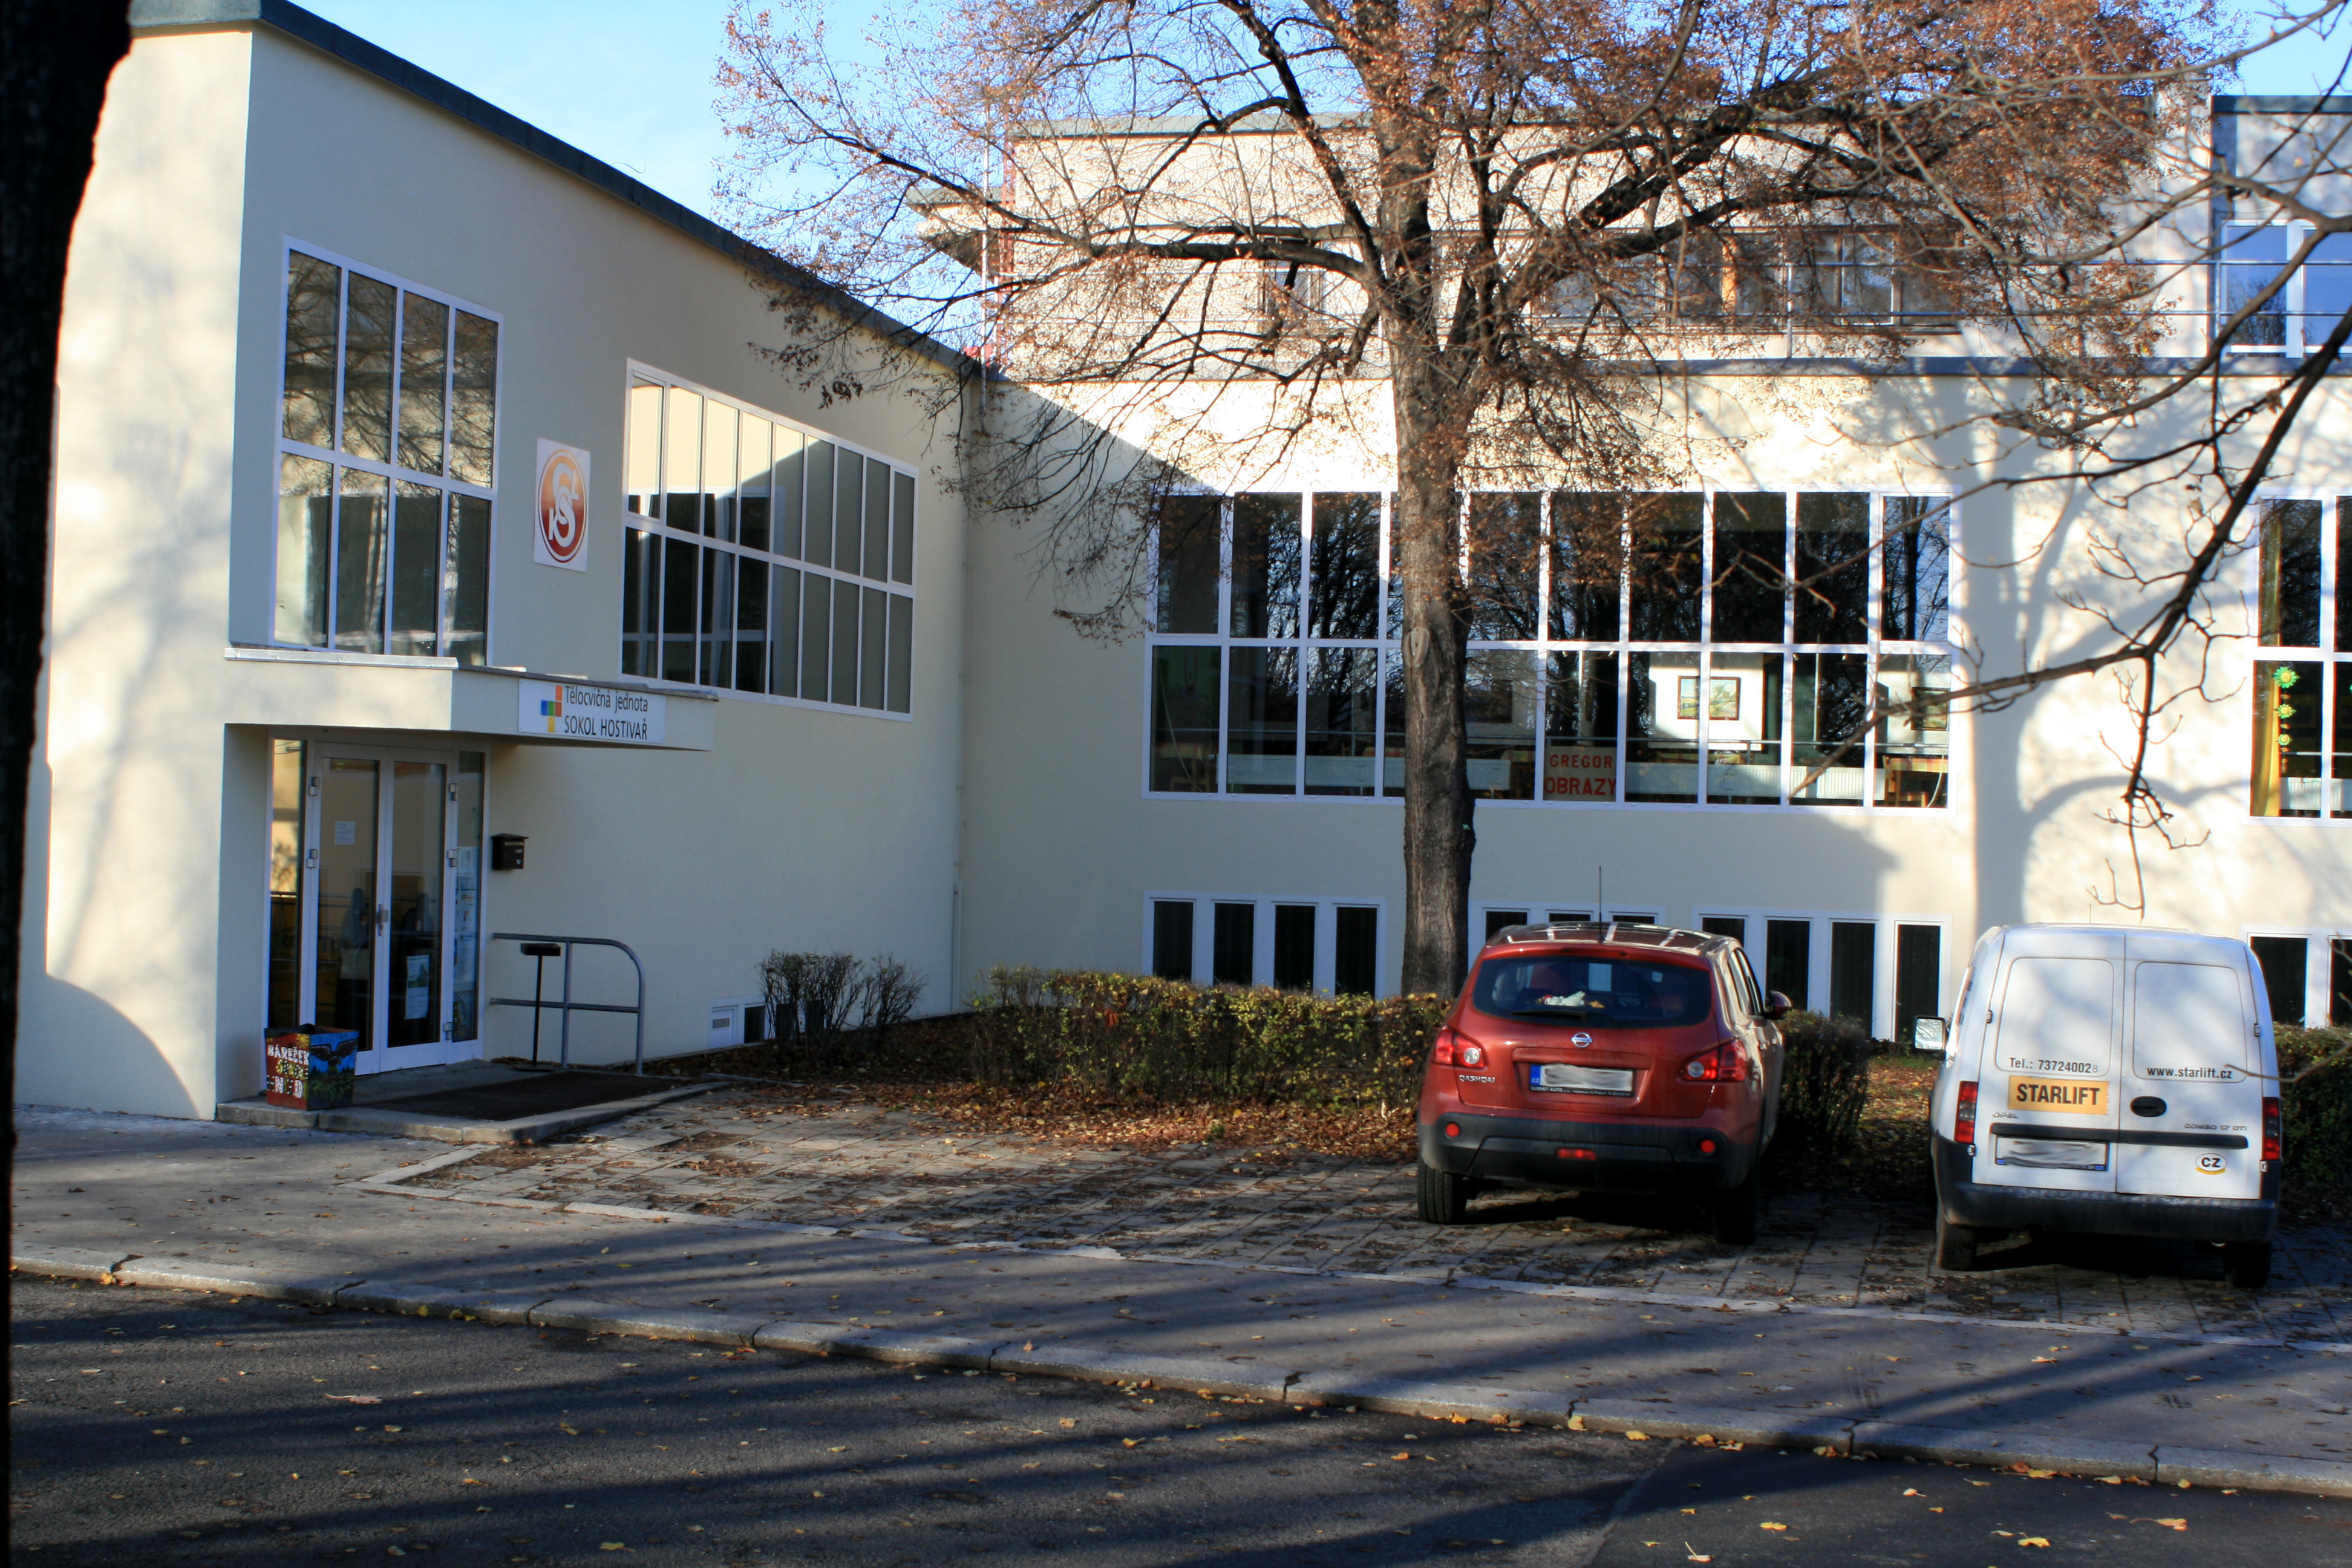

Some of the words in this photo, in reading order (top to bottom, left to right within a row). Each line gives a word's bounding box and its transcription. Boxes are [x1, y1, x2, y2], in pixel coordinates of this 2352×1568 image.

[565, 685, 610, 708] Tělocvičná
[615, 691, 648, 714] jednota
[564, 715, 596, 736] SOKOL
[601, 717, 648, 740] HOSTIVAŘ
[1550, 754, 1613, 769] GREGOR
[1544, 777, 1616, 796] OBRAZY
[2009, 1057, 2033, 1069] Tel.:
[2038, 1060, 2098, 1073] 737240028
[2147, 1067, 2232, 1079] www.starlift.cz
[1459, 1074, 1496, 1083] QASHQAI
[2016, 1083, 2100, 1105] STARLIFT
[2201, 1157, 2221, 1168] CZ
